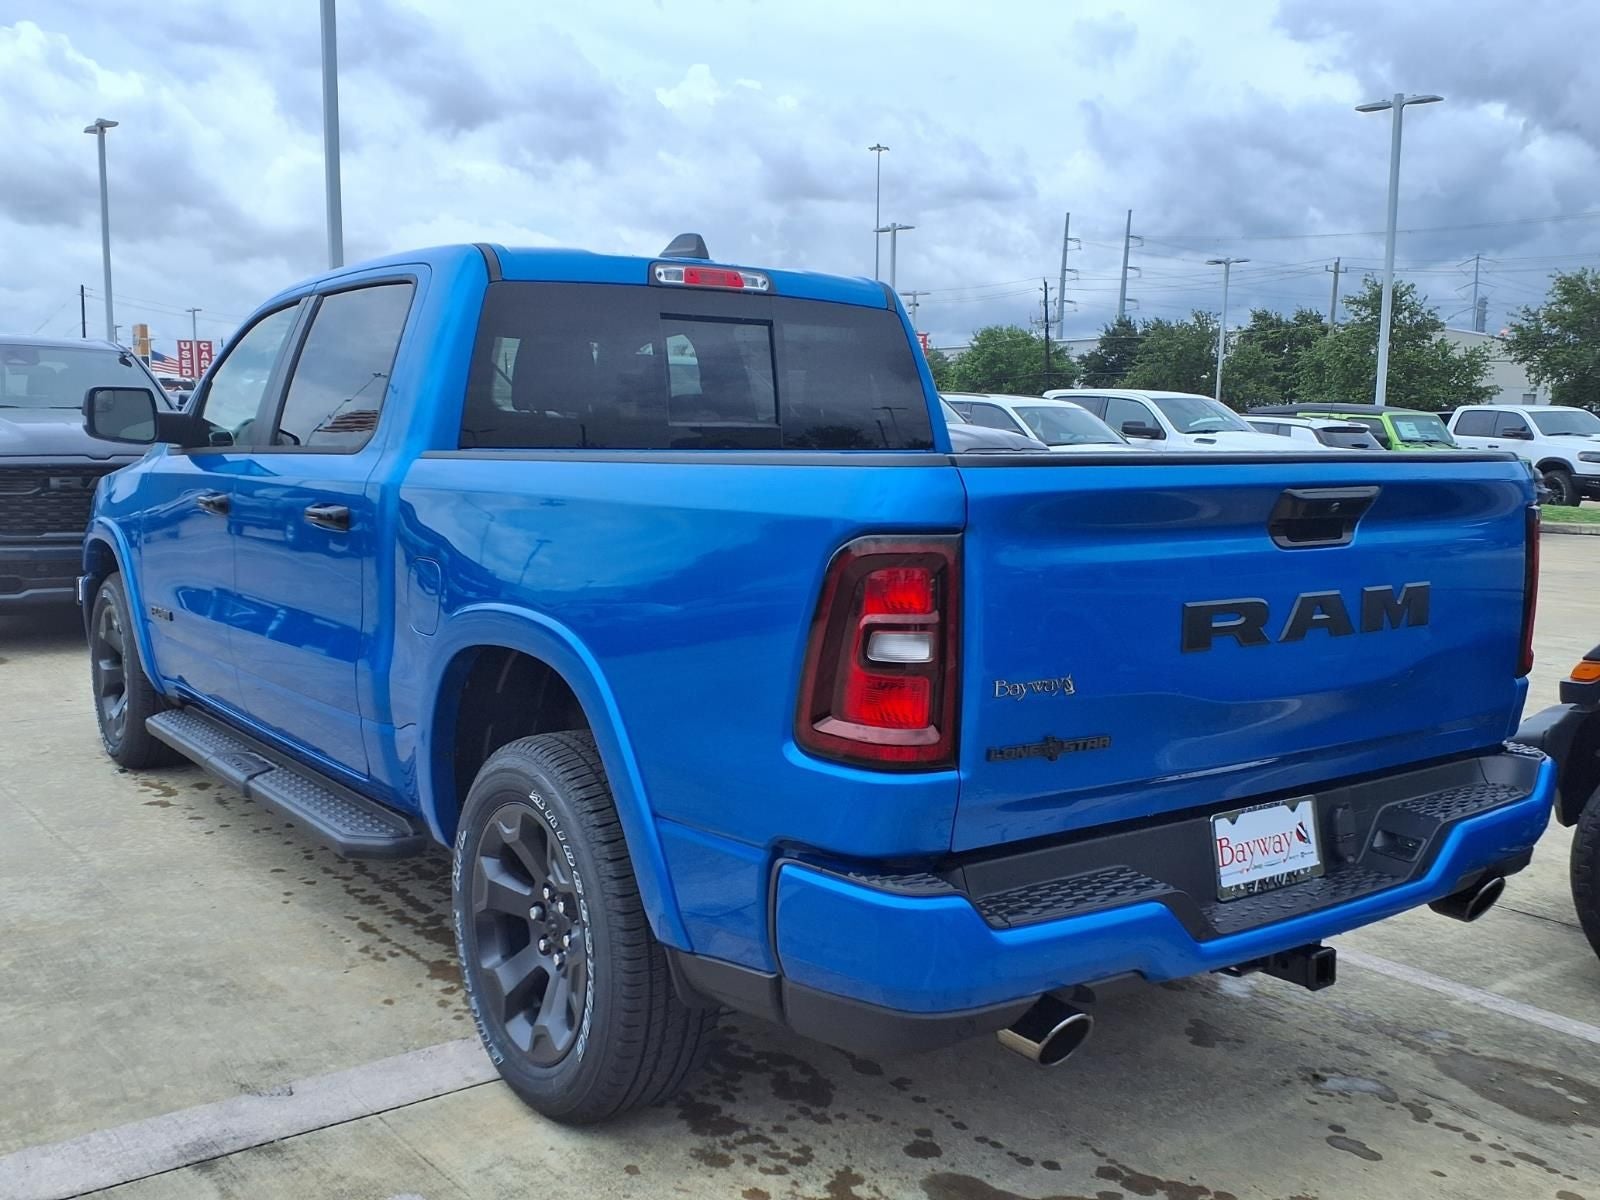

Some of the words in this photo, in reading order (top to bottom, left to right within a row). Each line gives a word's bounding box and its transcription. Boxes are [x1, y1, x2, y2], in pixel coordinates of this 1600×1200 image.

[180, 342, 192, 375] USED
[1181, 581, 1432, 654] RAM
[994, 679, 1067, 701] Bayway
[986, 743, 1045, 762] LONE
[1062, 736, 1111, 753] STAR
[1217, 831, 1293, 873] Bayway
